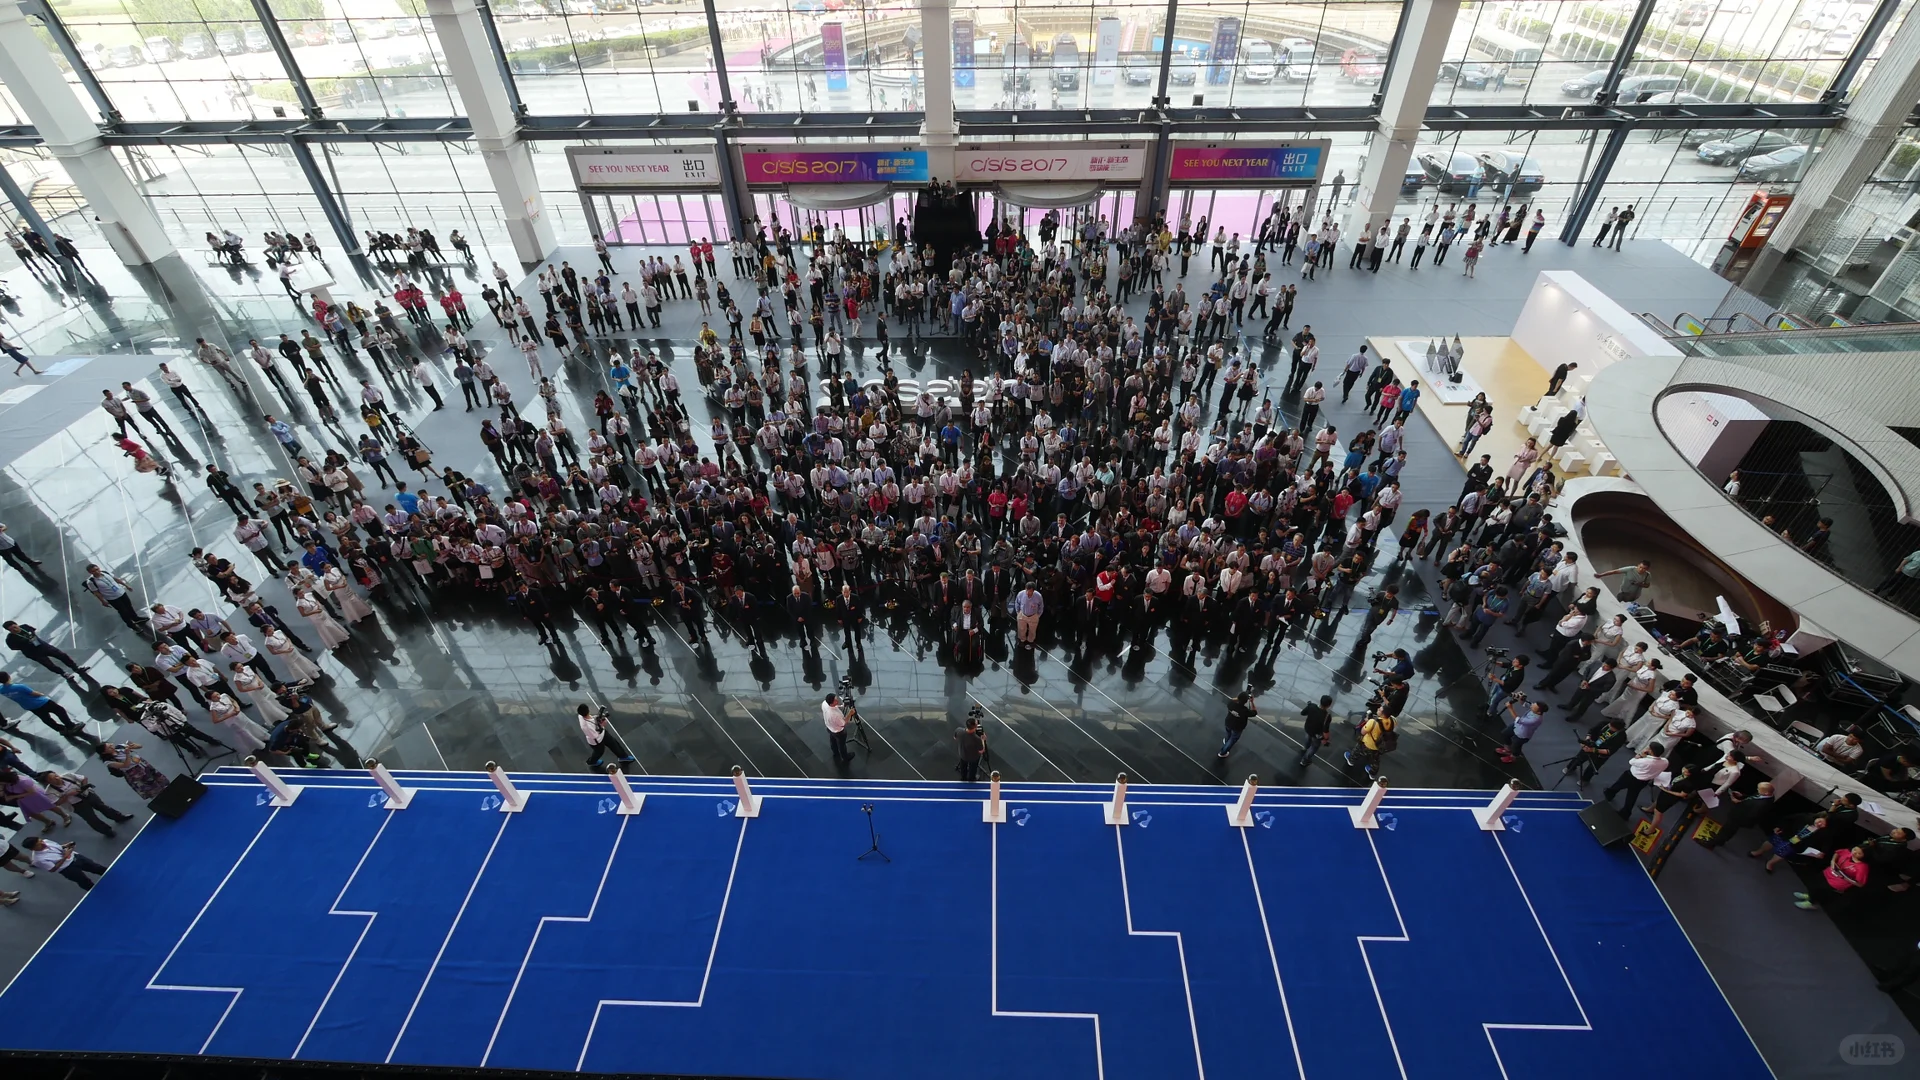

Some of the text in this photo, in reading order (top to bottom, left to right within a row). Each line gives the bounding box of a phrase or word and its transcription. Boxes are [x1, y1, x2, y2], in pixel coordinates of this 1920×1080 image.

[682, 159, 705, 171] 出口
[1020, 159, 1068, 171] 2017
[1184, 159, 1269, 167] SEE YOU NEXT YEAR
[1282, 153, 1308, 165] 出口
[588, 165, 670, 173] SEE YOU NEXT YEAR
[811, 161, 857, 174] 2017
